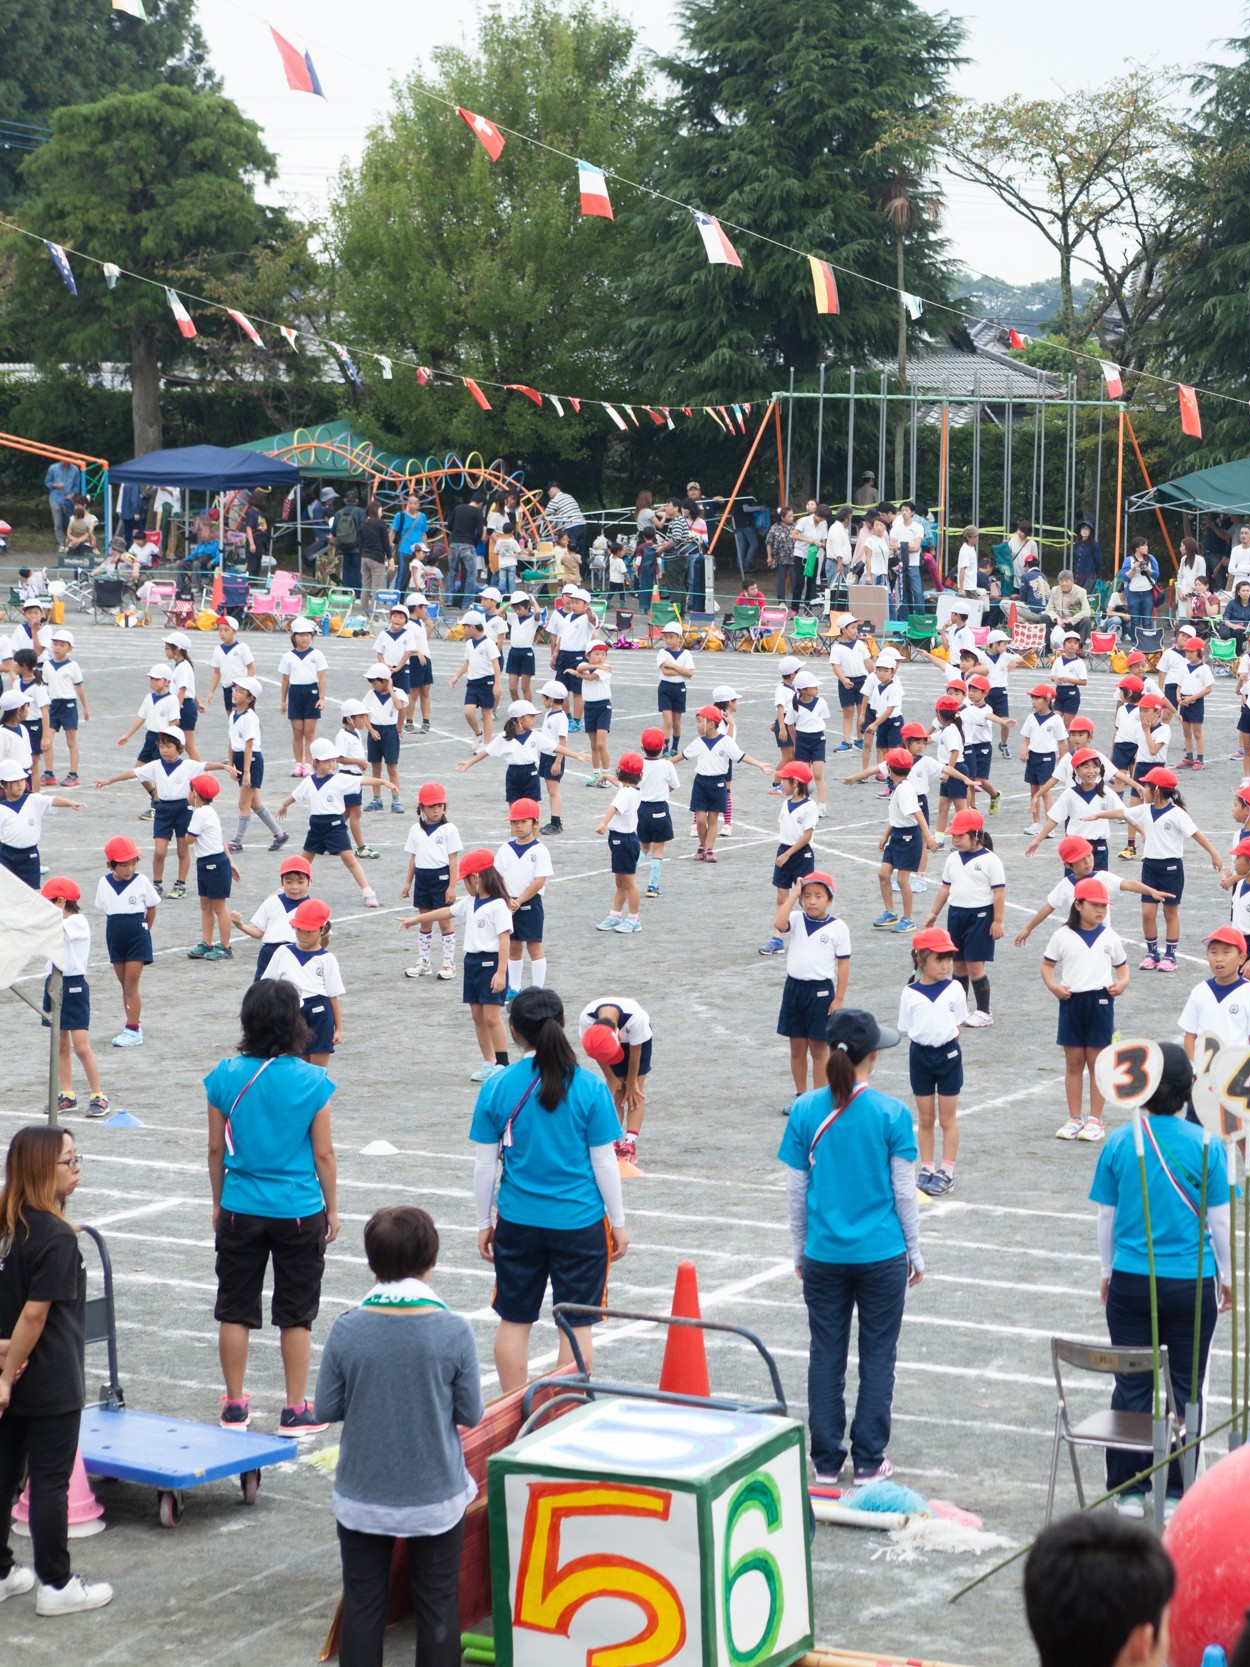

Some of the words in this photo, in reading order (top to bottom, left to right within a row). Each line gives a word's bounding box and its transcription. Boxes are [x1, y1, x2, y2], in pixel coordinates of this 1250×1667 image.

[1113, 1044, 1150, 1100] 3
[550, 1402, 777, 1470] 3
[512, 1482, 687, 1667] 5
[721, 1470, 785, 1667] 6
